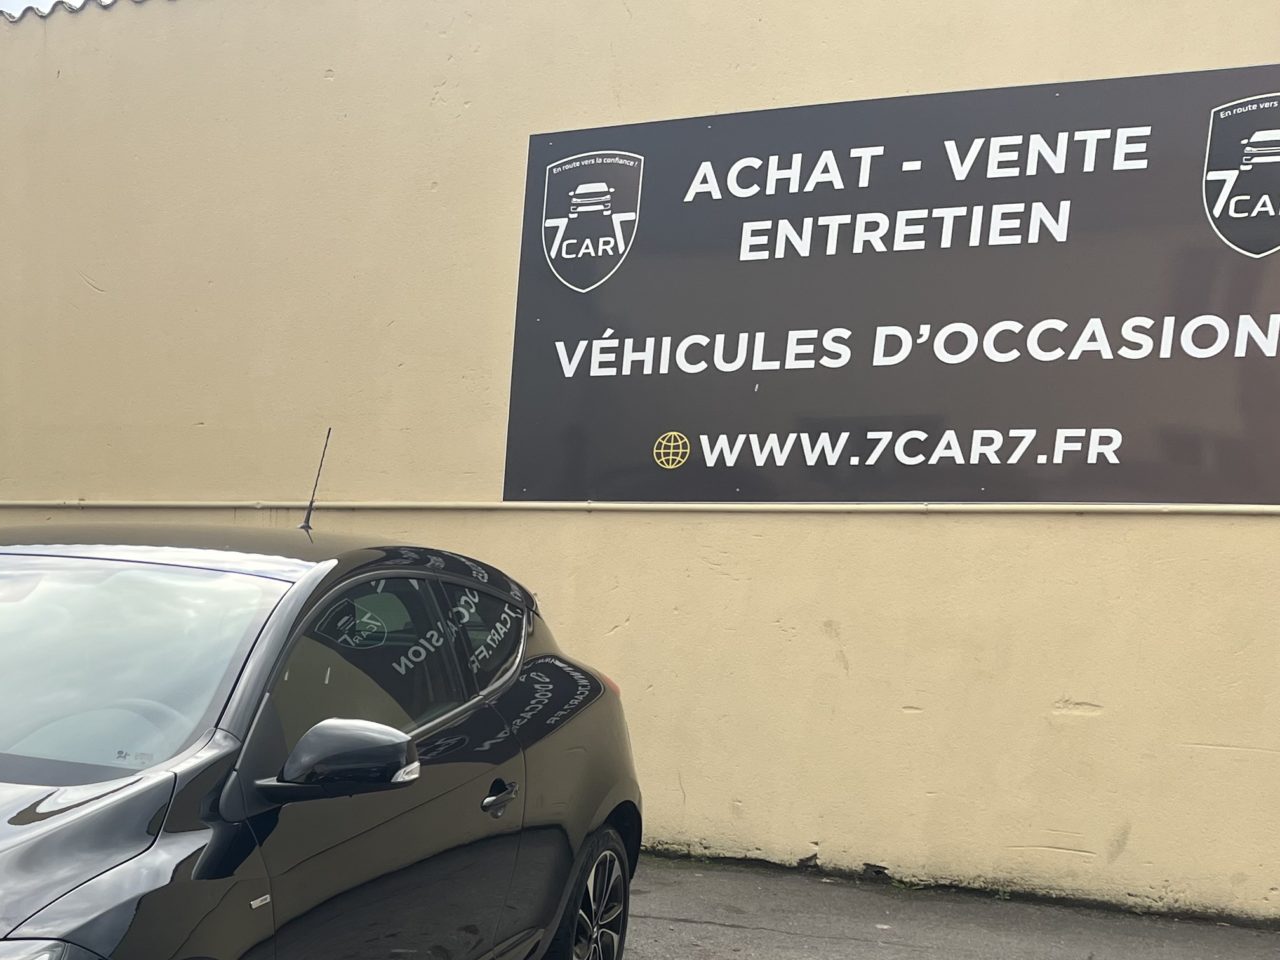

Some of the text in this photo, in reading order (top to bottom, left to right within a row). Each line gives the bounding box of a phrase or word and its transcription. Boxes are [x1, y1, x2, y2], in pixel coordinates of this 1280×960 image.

[1220, 101, 1279, 119] En route vers
[562, 161, 580, 171] route
[683, 145, 885, 203] ACHAT
[943, 125, 1152, 182] VENTE
[739, 200, 1072, 262] ENTRETIEN
[554, 327, 853, 379] VÉHICULES
[699, 427, 1123, 468] WWW.7CAR7.FR
